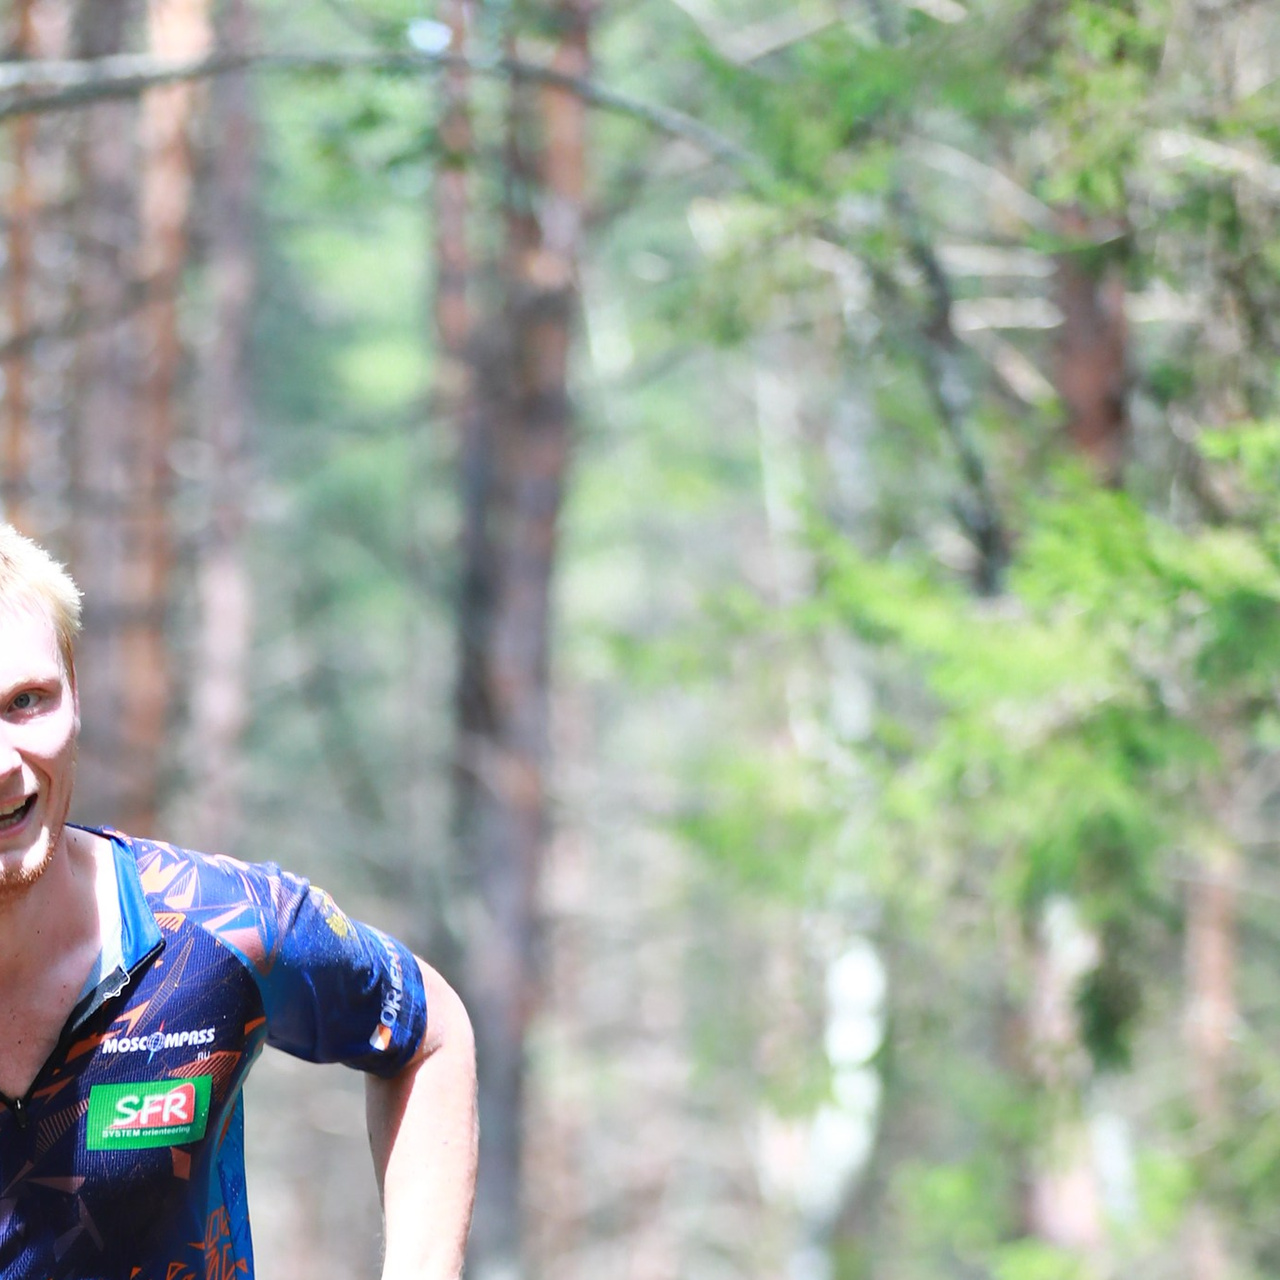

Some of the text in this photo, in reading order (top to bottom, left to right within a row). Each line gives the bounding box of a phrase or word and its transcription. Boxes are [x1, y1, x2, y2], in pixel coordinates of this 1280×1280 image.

[102, 1026, 216, 1055] MOSCOMPASS
[113, 1091, 188, 1127] SFR
[102, 1125, 191, 1139] SYSTEM orienteering
